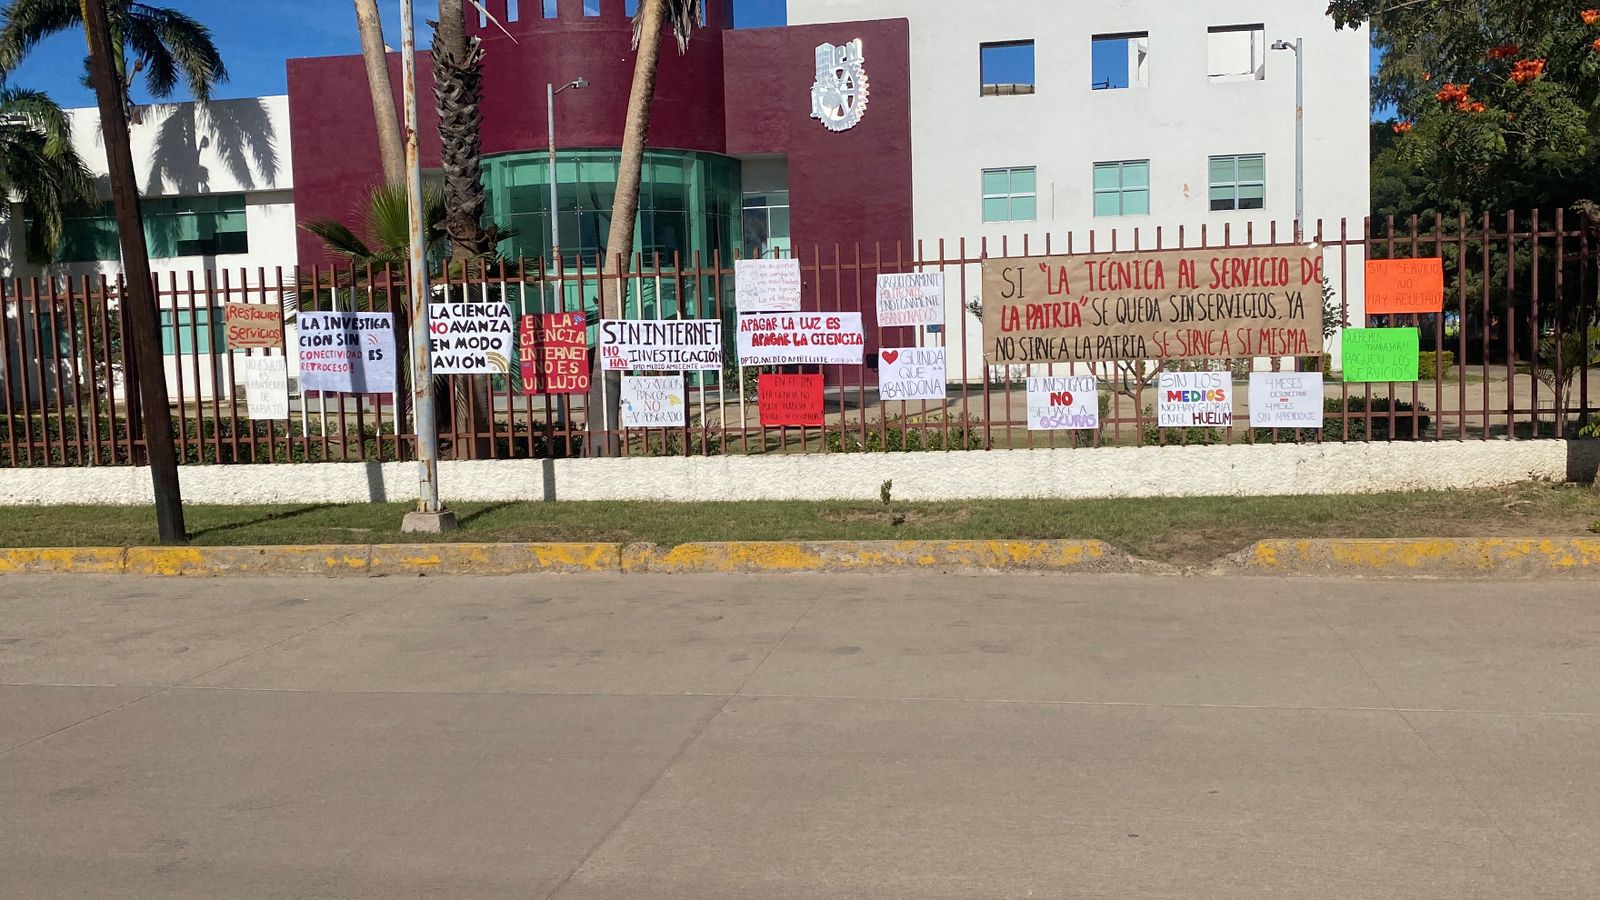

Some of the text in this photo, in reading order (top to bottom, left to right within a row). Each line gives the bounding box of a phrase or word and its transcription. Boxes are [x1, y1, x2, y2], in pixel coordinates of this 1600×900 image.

[1368, 263, 1388, 275] SIN
[1001, 268, 1025, 300] SI
[1085, 256, 1165, 294] TÉCNICA
[1178, 259, 1199, 290] AL
[1209, 257, 1288, 291] SERVICIO
[1300, 256, 1322, 287] DE
[1397, 278, 1413, 289] NO
[880, 295, 941, 312] INDIGNAMENTE
[1368, 294, 1388, 306] HAY
[430, 304, 511, 320] LA CIENCIA
[1000, 304, 1020, 334] LA
[1092, 297, 1109, 327] SE
[1116, 296, 1162, 325] QUEDA
[1169, 294, 1194, 324] SIN
[1284, 291, 1305, 320] YA
[302, 314, 390, 331] LA INVESTIGA
[430, 320, 511, 335] NO AVANZA
[525, 315, 572, 329] EN LA
[741, 317, 840, 332] APAGAR LA LUZ ES
[299, 332, 359, 348] CIÓN SIN
[521, 329, 585, 346] CIENCIA
[603, 321, 721, 346] SIN INTERNET
[752, 333, 864, 347] APAGAR LA CIENCIA
[1344, 330, 1381, 344] QUEREMOS
[430, 337, 502, 354] EN MODO
[603, 346, 620, 358] NO
[995, 337, 1015, 362] NO
[1019, 336, 1058, 361] SIRVE
[1057, 337, 1069, 361] A
[1074, 336, 1091, 360] LA
[1152, 331, 1170, 358] SE
[1175, 329, 1215, 358] SIRVE
[1217, 329, 1231, 356] A
[1237, 328, 1253, 355] SI
[300, 349, 384, 362] CONECTIVIDAD ES
[434, 353, 486, 370] AVIÓN
[520, 347, 588, 362] INTERNET
[610, 348, 721, 368] HAY INVESTIGACIÓN
[900, 349, 944, 366] GUINDA
[1344, 352, 1411, 367] PAGUEN LOS
[533, 361, 579, 375] NO ES
[899, 367, 925, 379] QUE
[524, 375, 588, 391] UN LUJO
[775, 376, 786, 387] EN
[881, 378, 944, 398] ABANDONA
[1028, 378, 1039, 393] LA
[1161, 373, 1222, 388] SIN LOS
[1273, 377, 1303, 390] MESES
[1050, 391, 1074, 407] NO
[1167, 389, 1226, 402] MEDIOS
[644, 400, 661, 412] NO
[1032, 404, 1088, 418] SE HACE A
[1161, 402, 1231, 412] NO HAY GLORIA
[1265, 402, 1296, 411] 4 MESES
[1040, 414, 1096, 429] OSCURAS
[1161, 412, 1232, 425] EN EL HUELUM
[1257, 411, 1316, 423] SIN APRENDIZAJE
